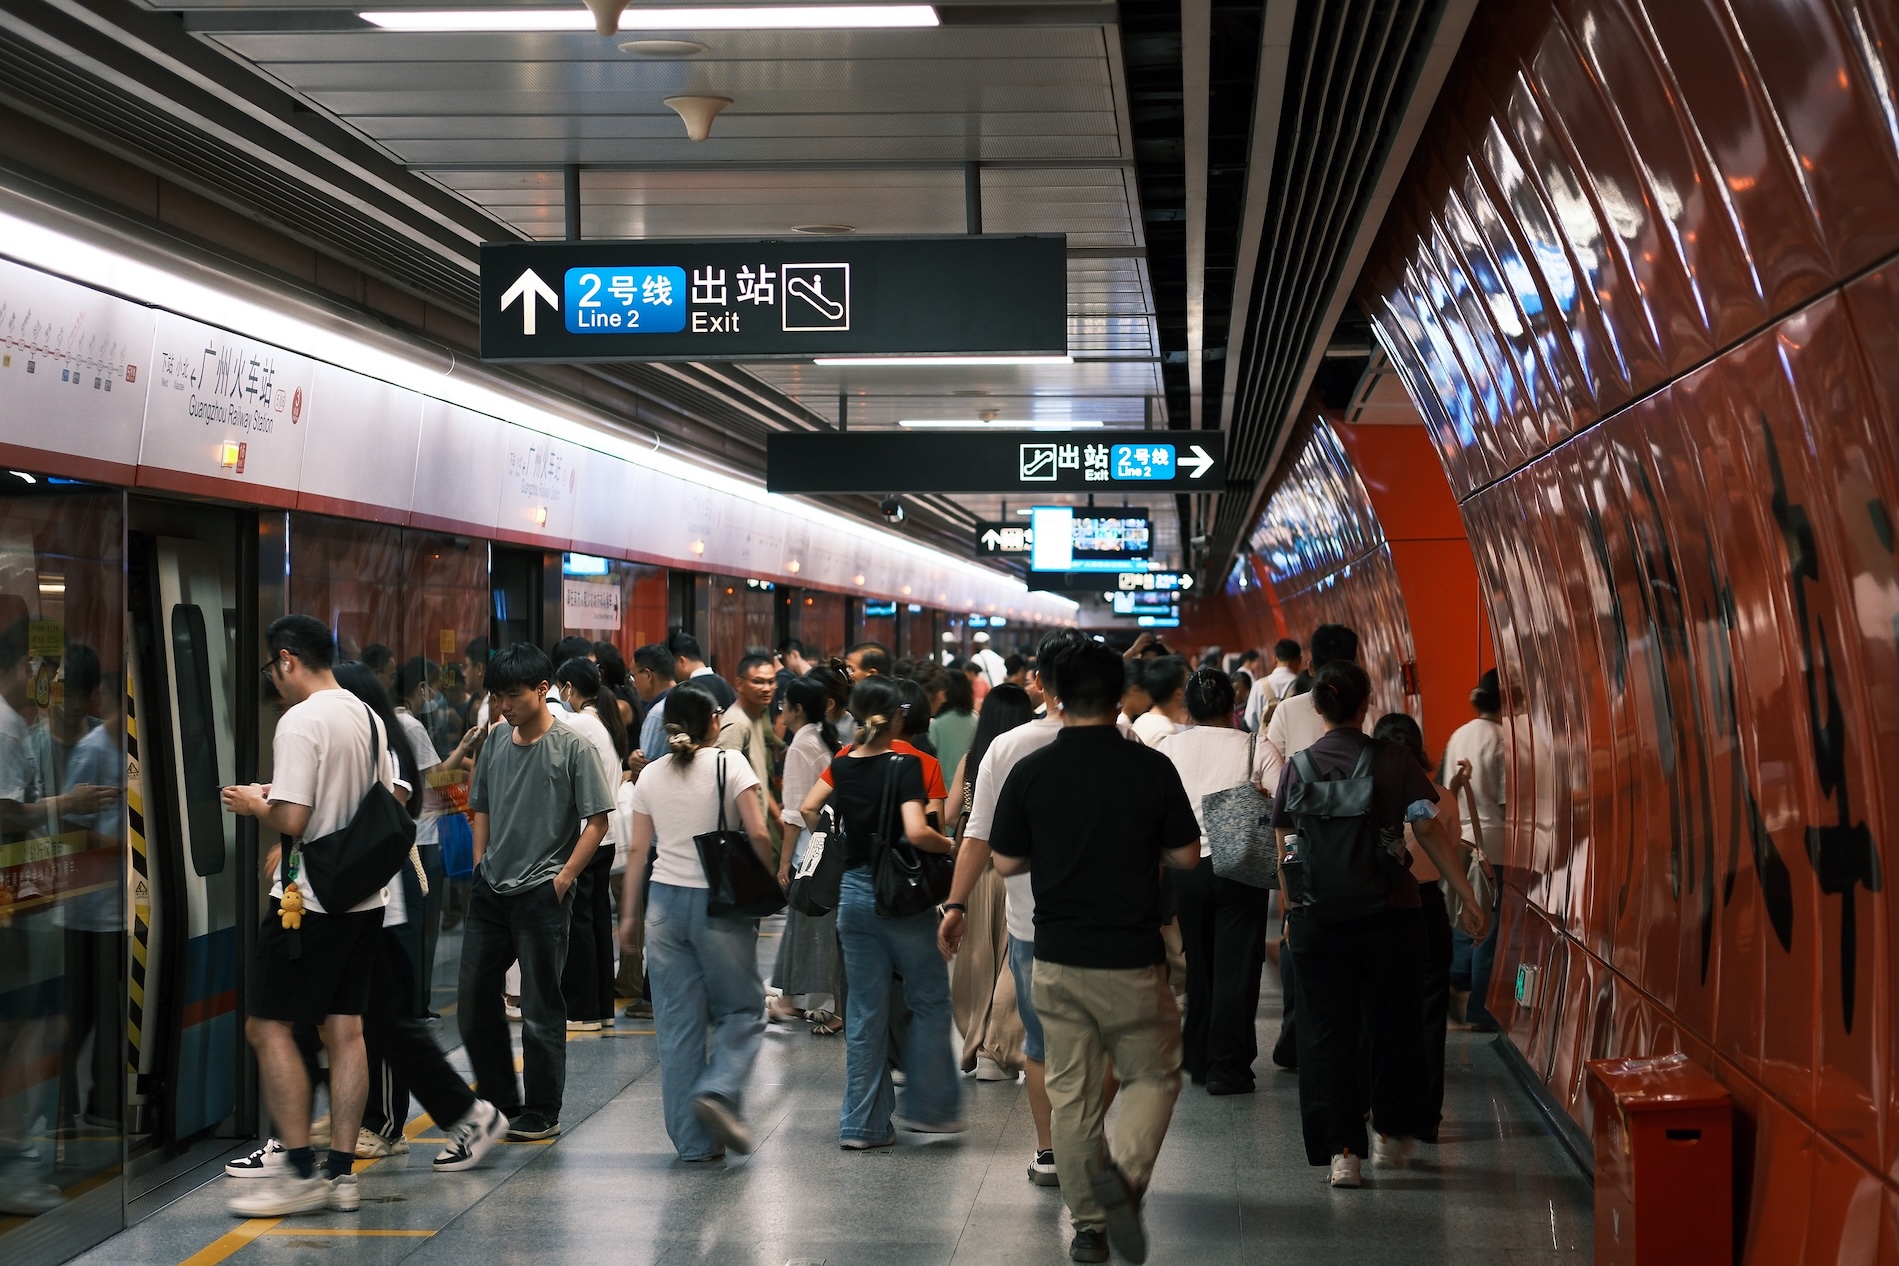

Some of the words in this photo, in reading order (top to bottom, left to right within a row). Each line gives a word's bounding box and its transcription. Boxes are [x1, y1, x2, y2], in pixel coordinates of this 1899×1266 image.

[578, 272, 673, 307] 2号线
[578, 310, 622, 327] Line
[627, 310, 640, 328] 2
[692, 311, 740, 333] Exit
[198, 340, 275, 409] 广州火车站
[188, 394, 228, 425] Guangzhou
[227, 403, 252, 434] Railway
[252, 409, 275, 434] Station
[1058, 444, 1109, 470] 出站
[1118, 447, 1169, 466] 2号线
[1084, 469, 1109, 481] Exit
[1118, 466, 1143, 477] Line
[1143, 466, 1152, 477] 2
